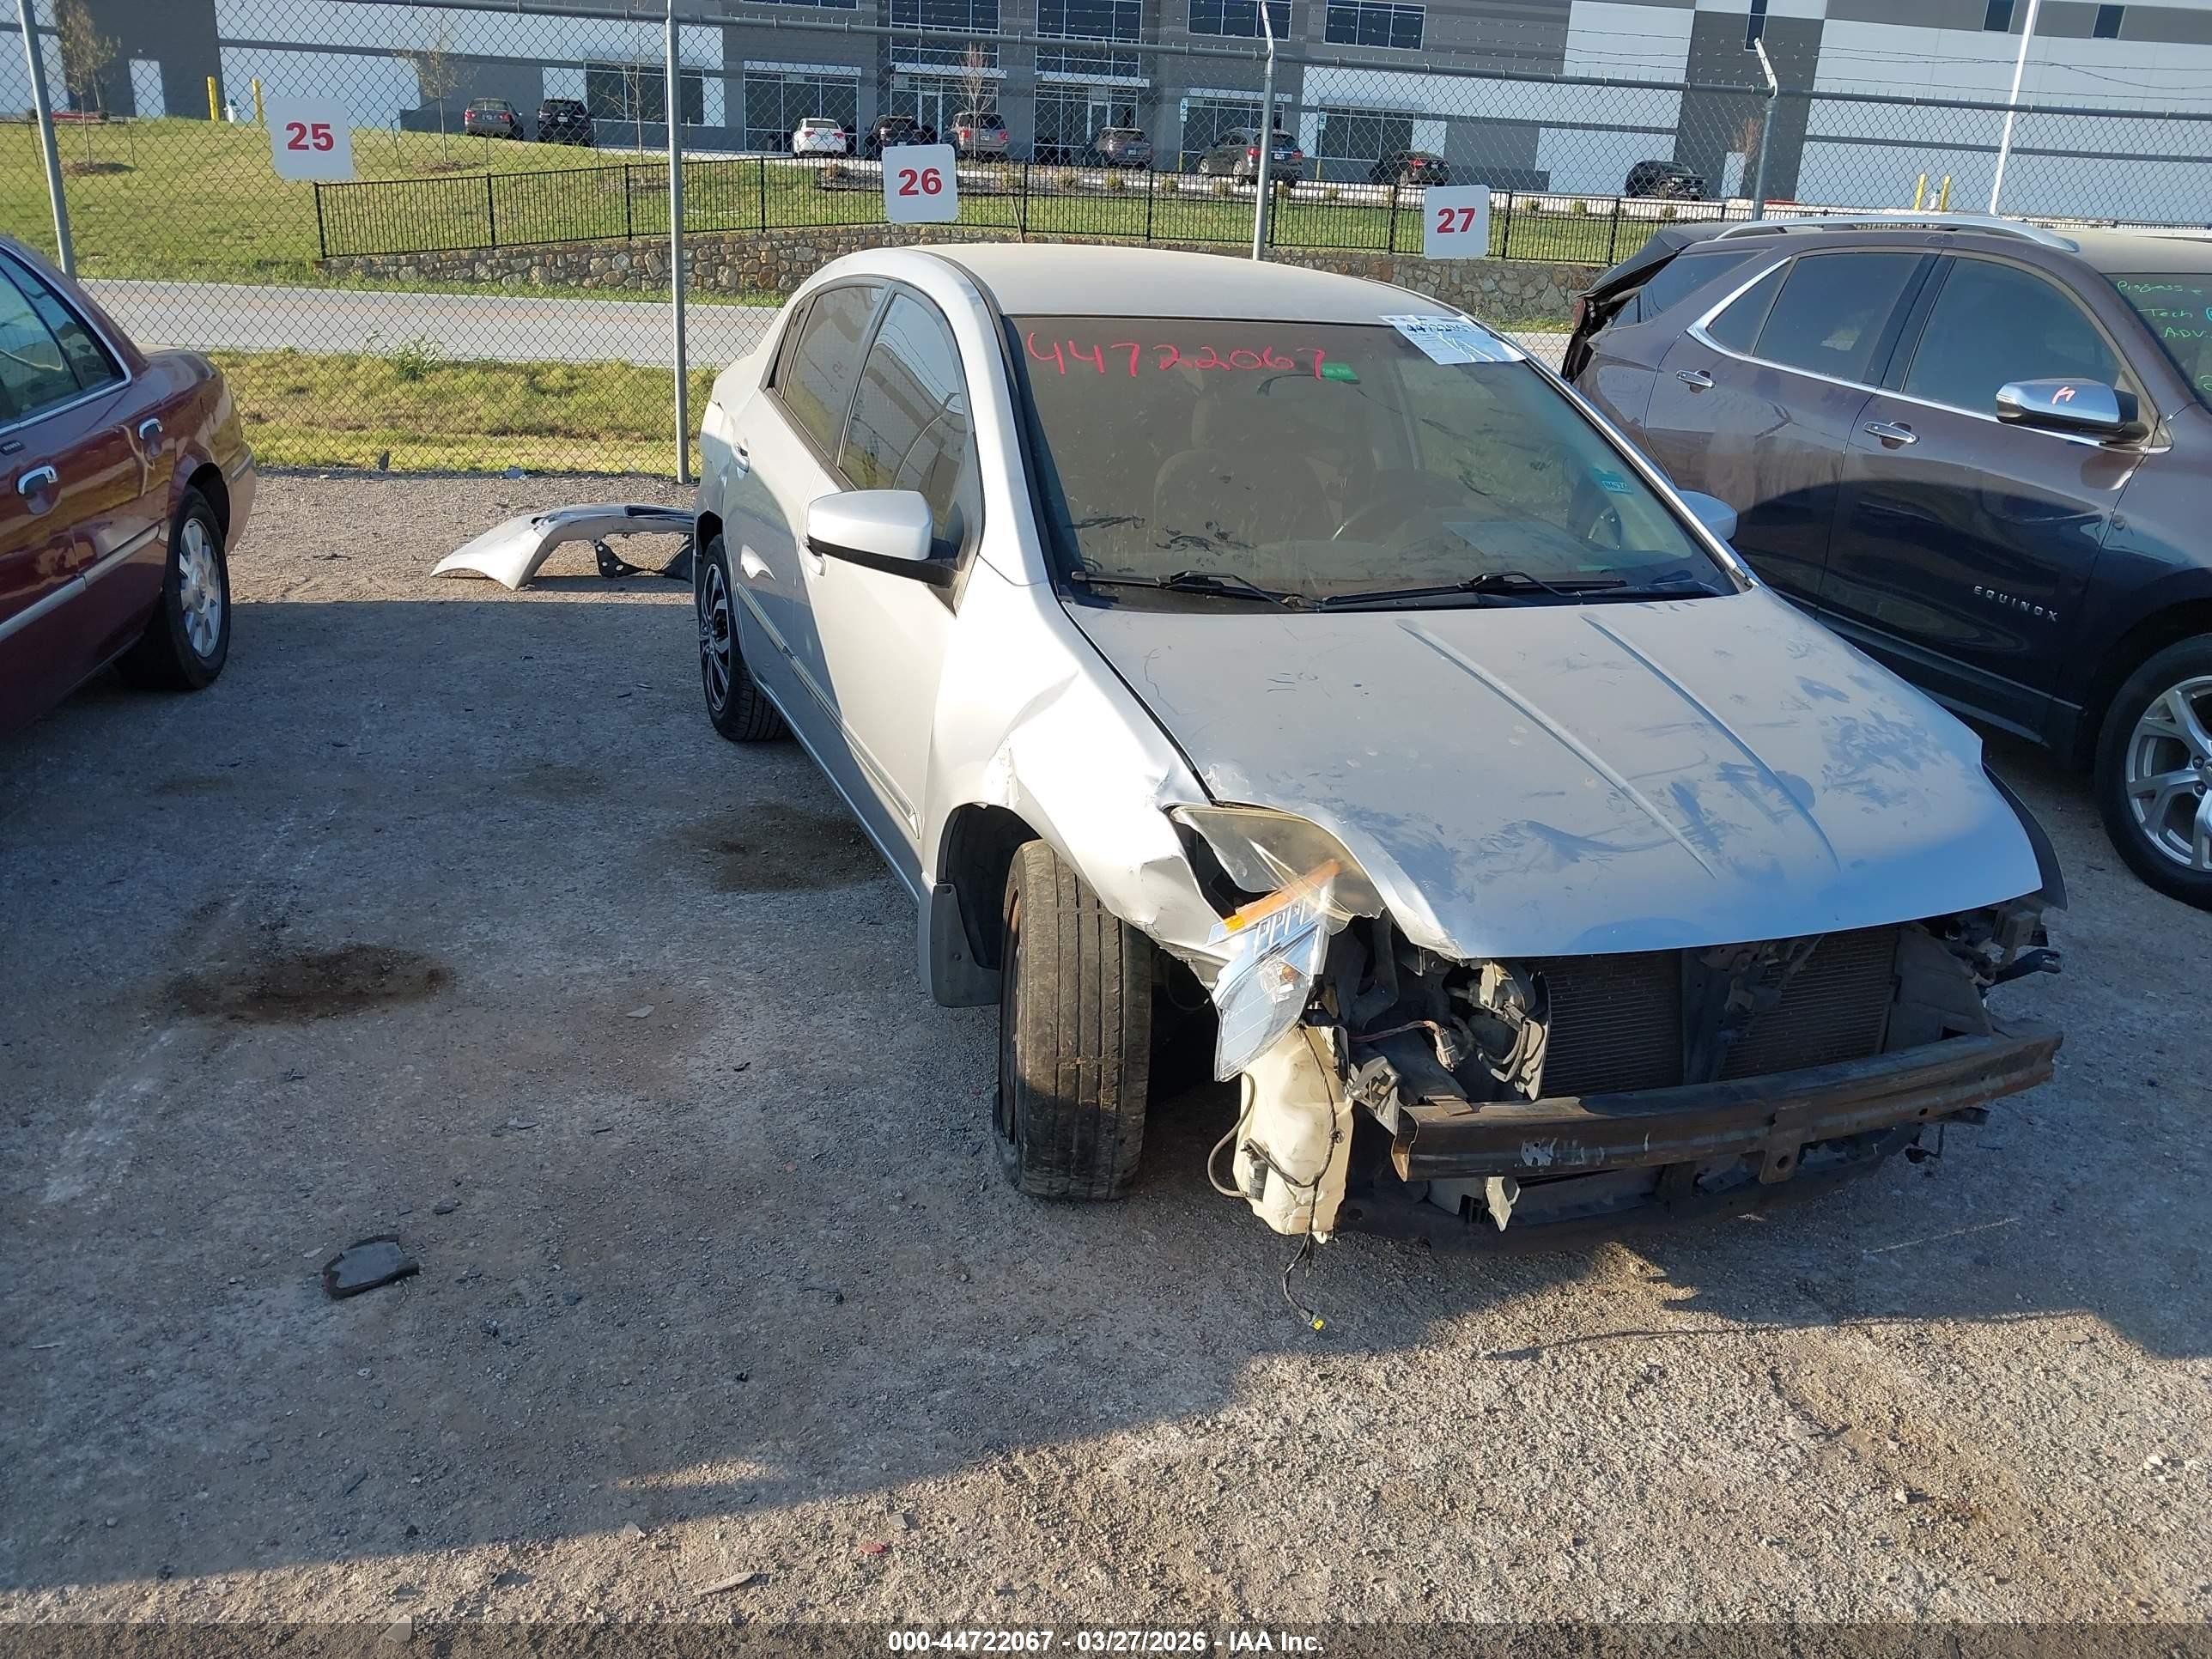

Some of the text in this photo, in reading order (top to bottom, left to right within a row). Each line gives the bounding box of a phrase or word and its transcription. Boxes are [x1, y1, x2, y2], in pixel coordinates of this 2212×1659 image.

[285, 122, 334, 152] 25
[898, 167, 943, 196] 26
[1437, 207, 1476, 234] 27
[1027, 332, 1325, 380] 44722067
[1974, 585, 2057, 622] EQUINOX
